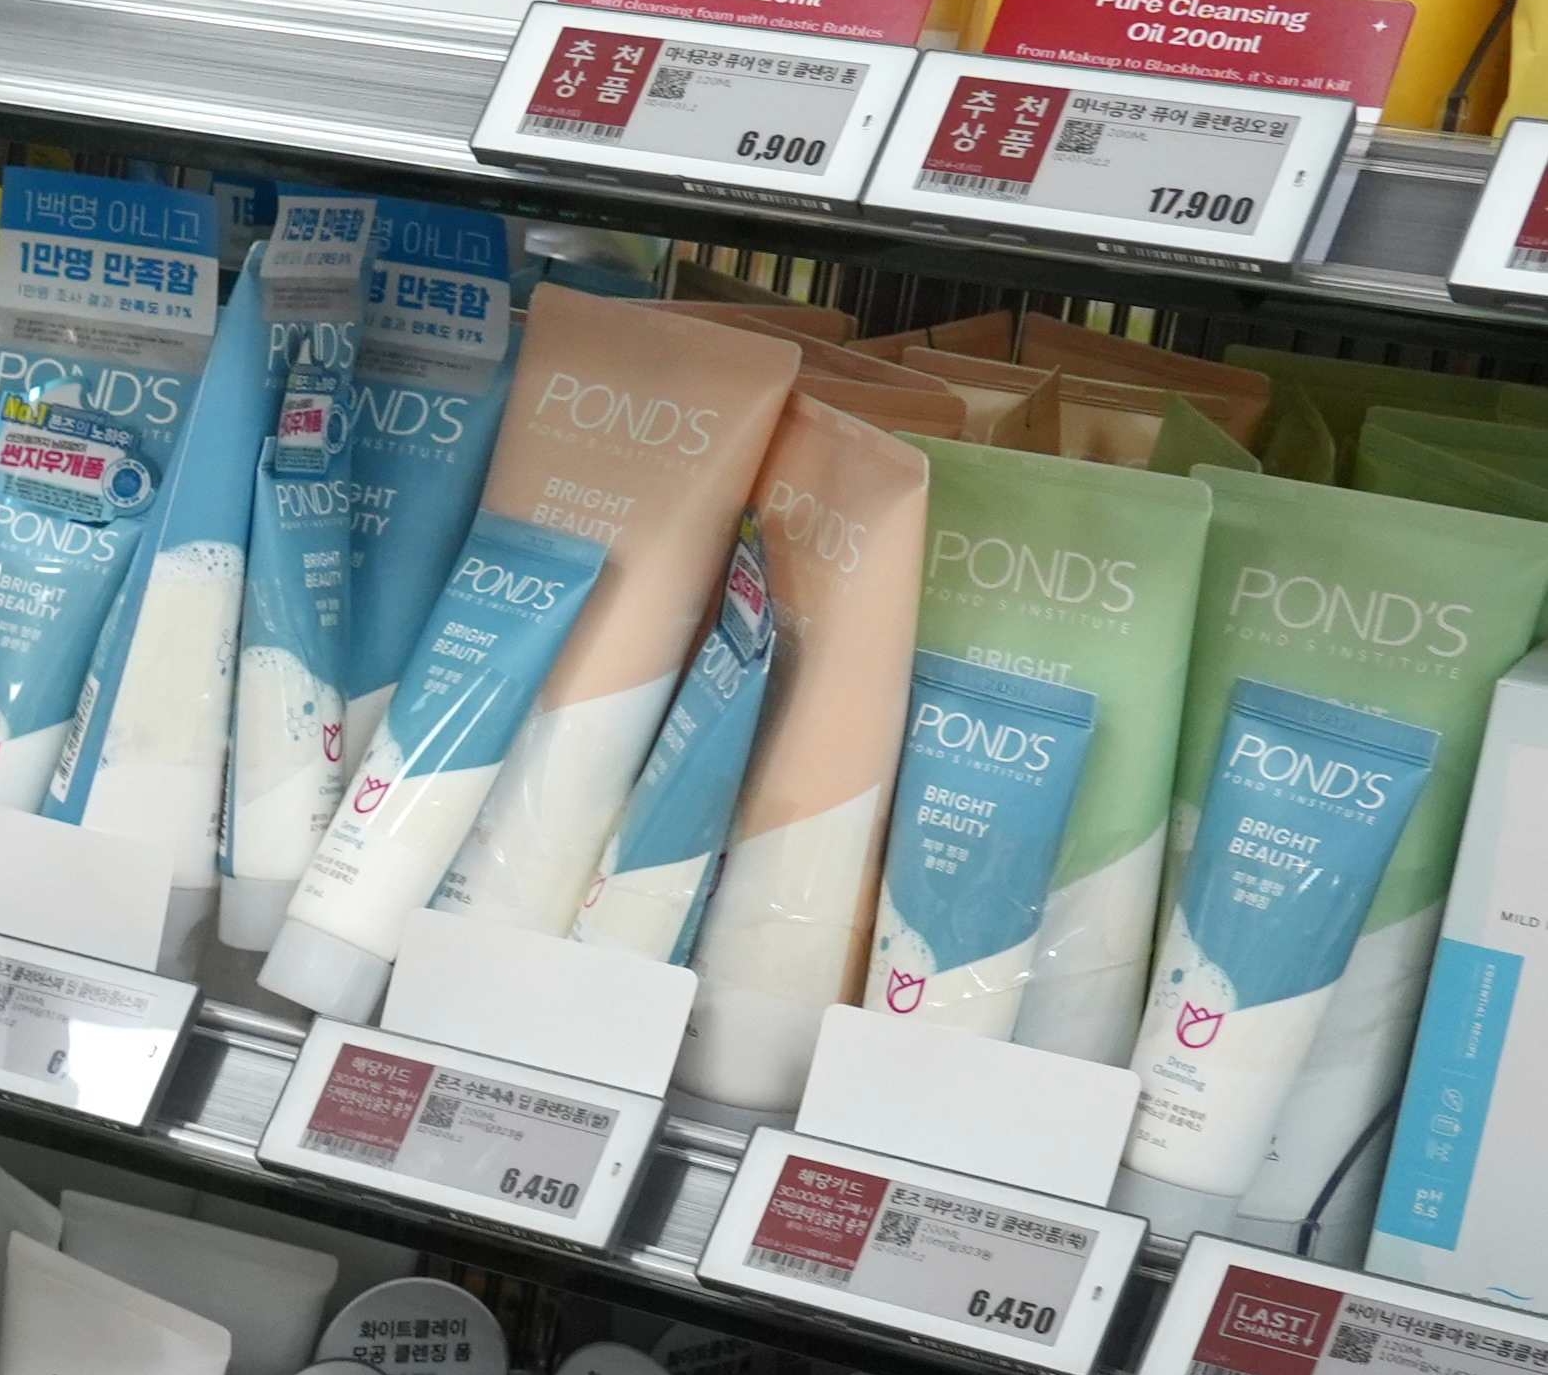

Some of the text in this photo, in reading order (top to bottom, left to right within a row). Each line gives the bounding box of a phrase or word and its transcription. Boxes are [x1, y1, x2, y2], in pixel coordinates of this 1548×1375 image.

[1127, 22, 1264, 54] Oil 200ml
[737, 130, 826, 167] 6,900
[23, 188, 202, 245] 1백명 아니고
[1148, 186, 1255, 225] 17,900
[19, 243, 200, 297] 1만명 만족함
[536, 372, 720, 456] POND'S
[545, 477, 635, 518] BRIGHT
[457, 556, 565, 612] POND'S
[928, 530, 1137, 613] POND'S
[1229, 566, 1475, 661] POND'S
[913, 702, 1057, 771] POND'S
[925, 784, 998, 819] BRIGHT
[917, 805, 991, 839] BEAUTY
[1239, 816, 1321, 854] BRIGHT
[1500, 909, 1541, 930] MILD
[500, 1167, 580, 1210] 6,450
[797, 1167, 865, 1196] 해당카드
[892, 1186, 921, 1210] 폰즈
[359, 1318, 468, 1341] 화이트클레이
[967, 1288, 1057, 1334] 6,450
[1236, 1304, 1307, 1334] LAST
[1232, 1321, 1299, 1346] CHANCE
